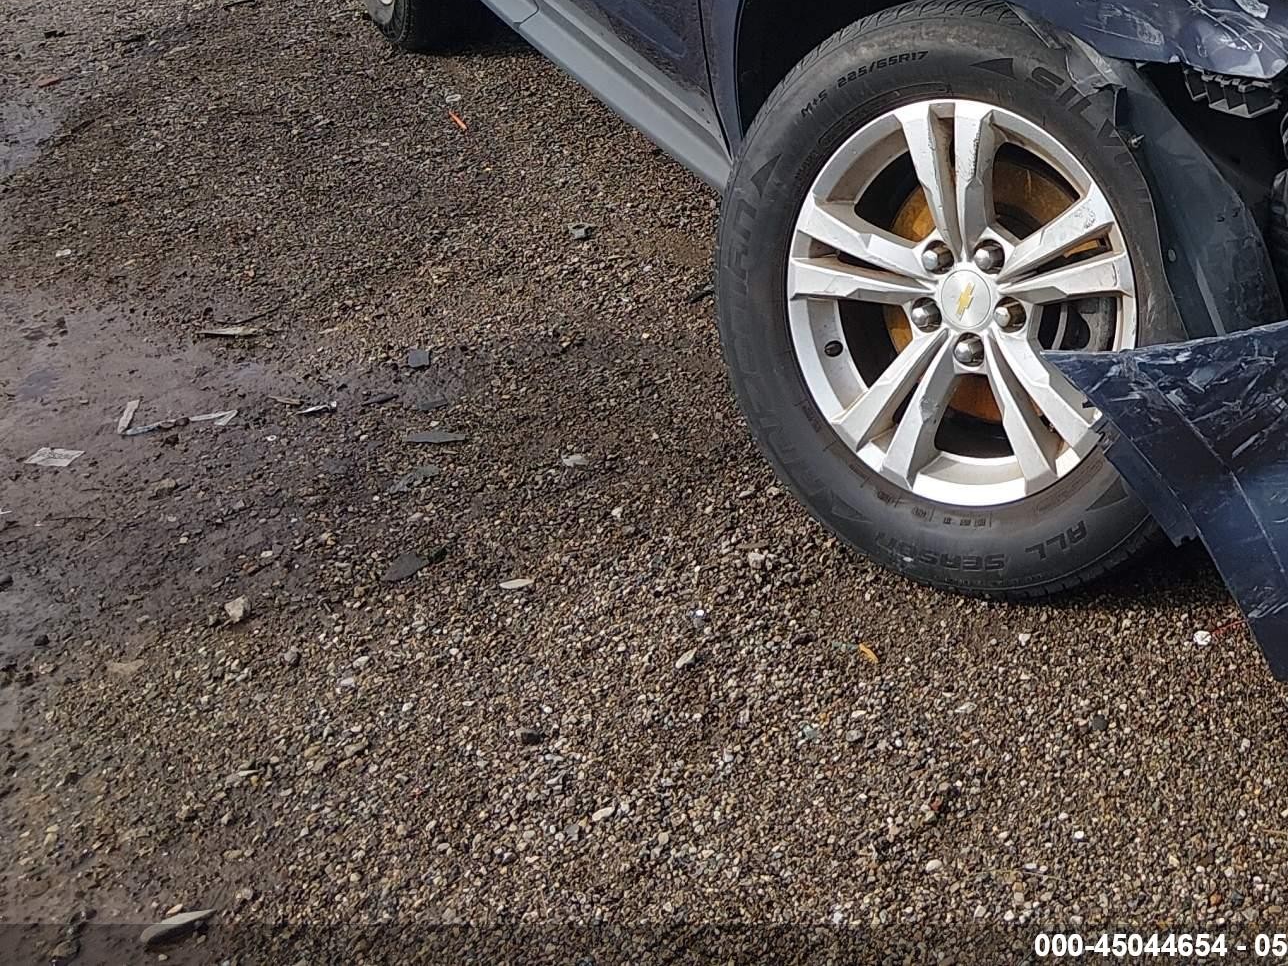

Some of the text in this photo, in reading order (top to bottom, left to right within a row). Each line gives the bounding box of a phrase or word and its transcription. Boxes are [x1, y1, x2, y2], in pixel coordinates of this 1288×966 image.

[800, 50, 930, 118] M+S 225/65R17
[875, 519, 1088, 572] ALL SEASON
